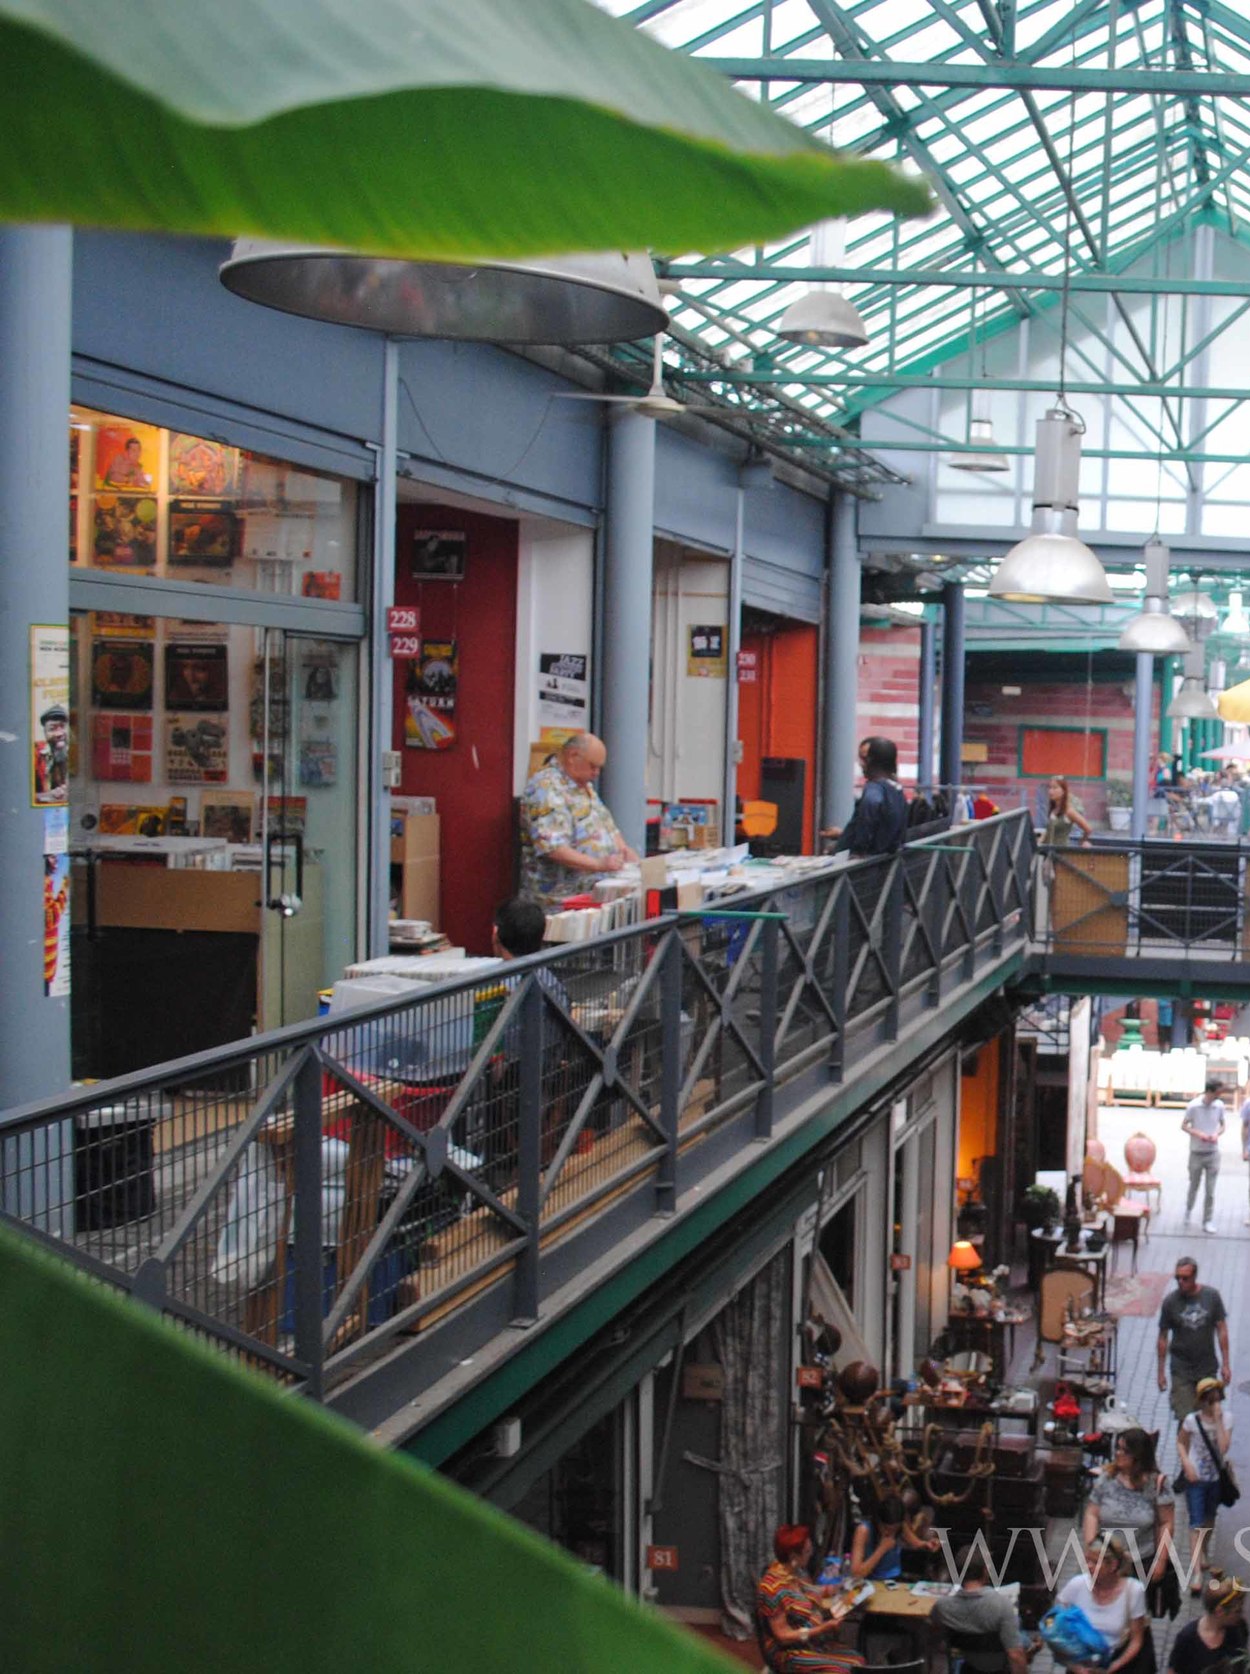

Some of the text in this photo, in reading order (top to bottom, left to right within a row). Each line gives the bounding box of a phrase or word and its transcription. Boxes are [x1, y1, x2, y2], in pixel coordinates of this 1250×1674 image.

[390, 610, 417, 628] 228
[392, 637, 418, 654] 229
[654, 1550, 671, 1566] 81
